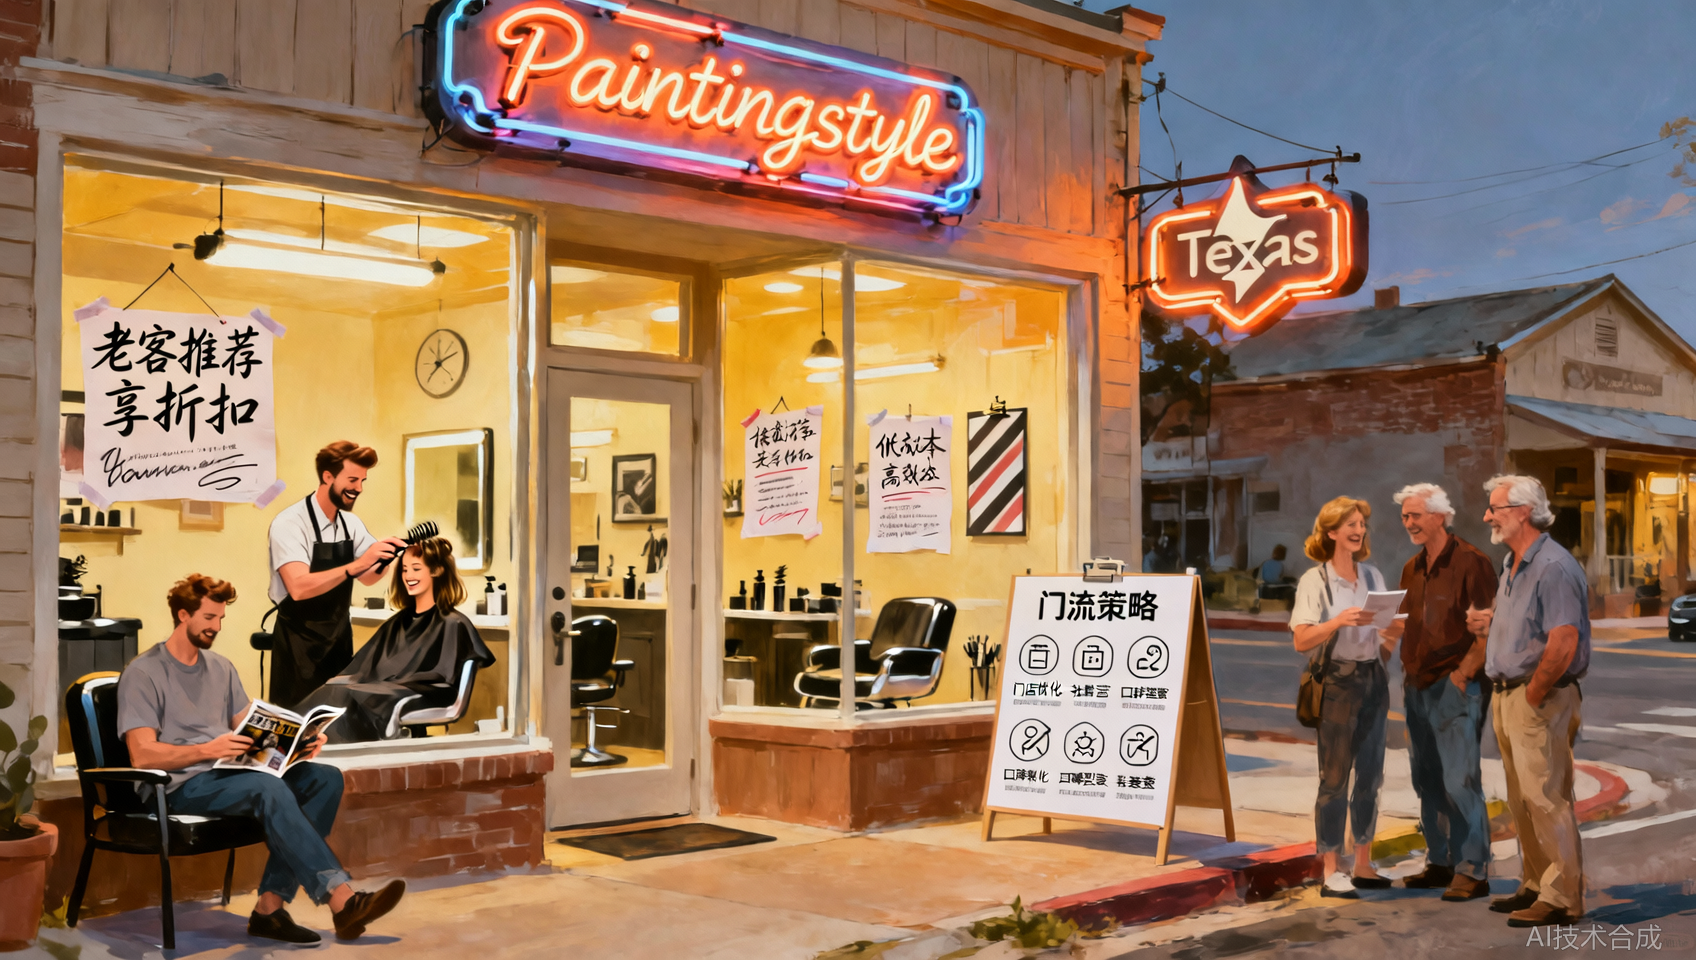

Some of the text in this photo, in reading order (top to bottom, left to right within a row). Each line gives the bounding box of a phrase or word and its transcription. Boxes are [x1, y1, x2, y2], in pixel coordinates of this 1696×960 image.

[497, 7, 958, 183] Paintingstyle
[1177, 229, 1319, 279] Texas
[91, 321, 263, 379] 老客推荐
[103, 379, 259, 442] 享折扣
[1038, 590, 1158, 621] 门流策略
